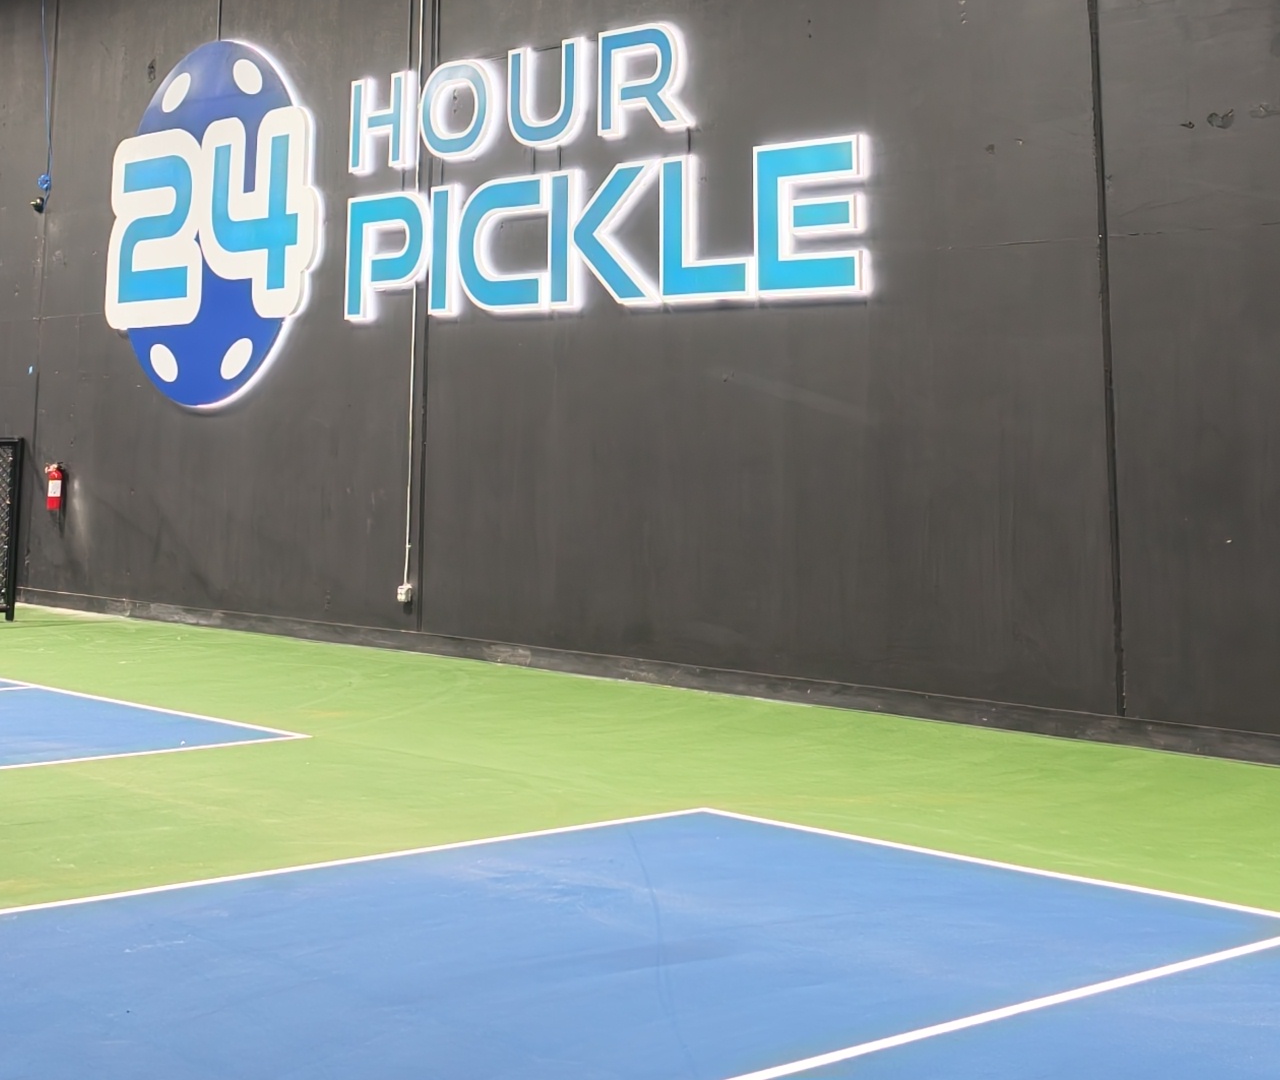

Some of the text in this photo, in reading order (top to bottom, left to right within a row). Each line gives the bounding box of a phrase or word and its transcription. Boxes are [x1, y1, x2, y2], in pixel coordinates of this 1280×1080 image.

[349, 24, 686, 172] HOUR
[114, 126, 303, 311] 24
[345, 136, 864, 319] PICKLE
